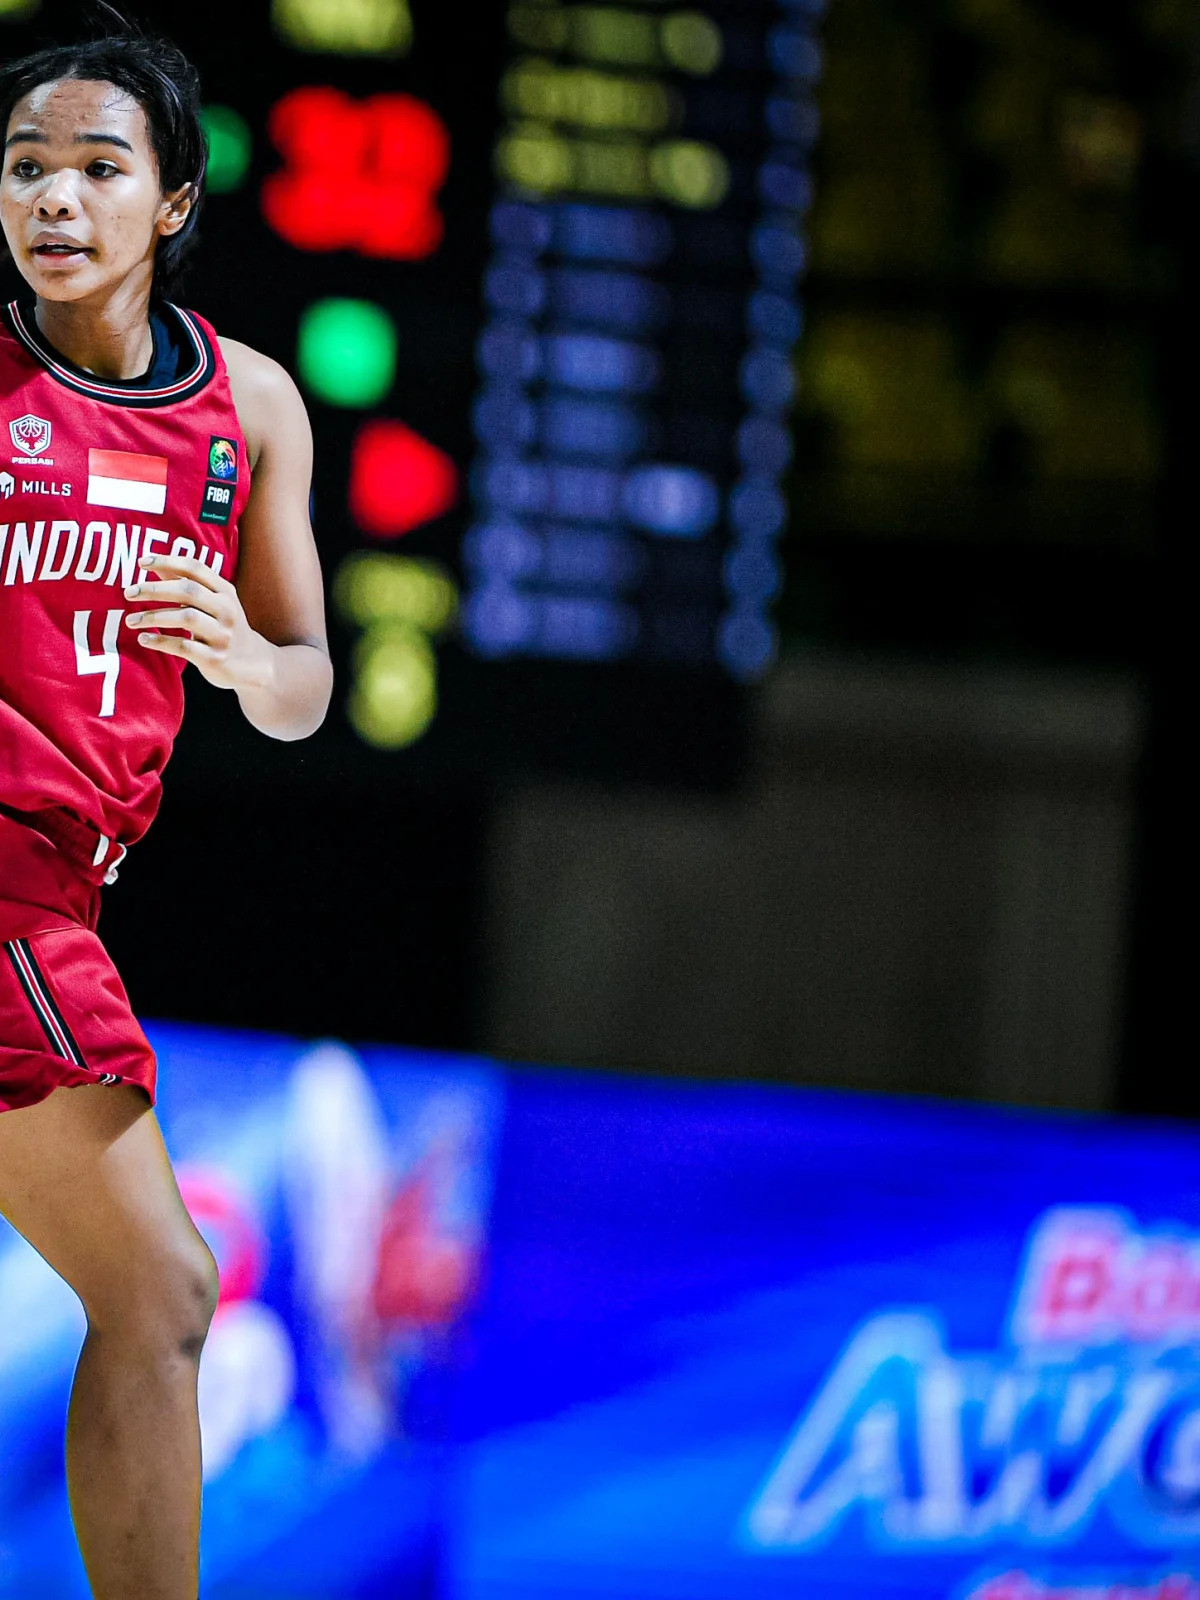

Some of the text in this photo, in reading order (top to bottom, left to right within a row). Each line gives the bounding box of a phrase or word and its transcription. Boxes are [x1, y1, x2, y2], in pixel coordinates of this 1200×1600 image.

[11, 456, 54, 466] PERBASI
[21, 480, 72, 497] MILLS
[206, 485, 231, 504] FIBA
[73, 609, 126, 717] 4
